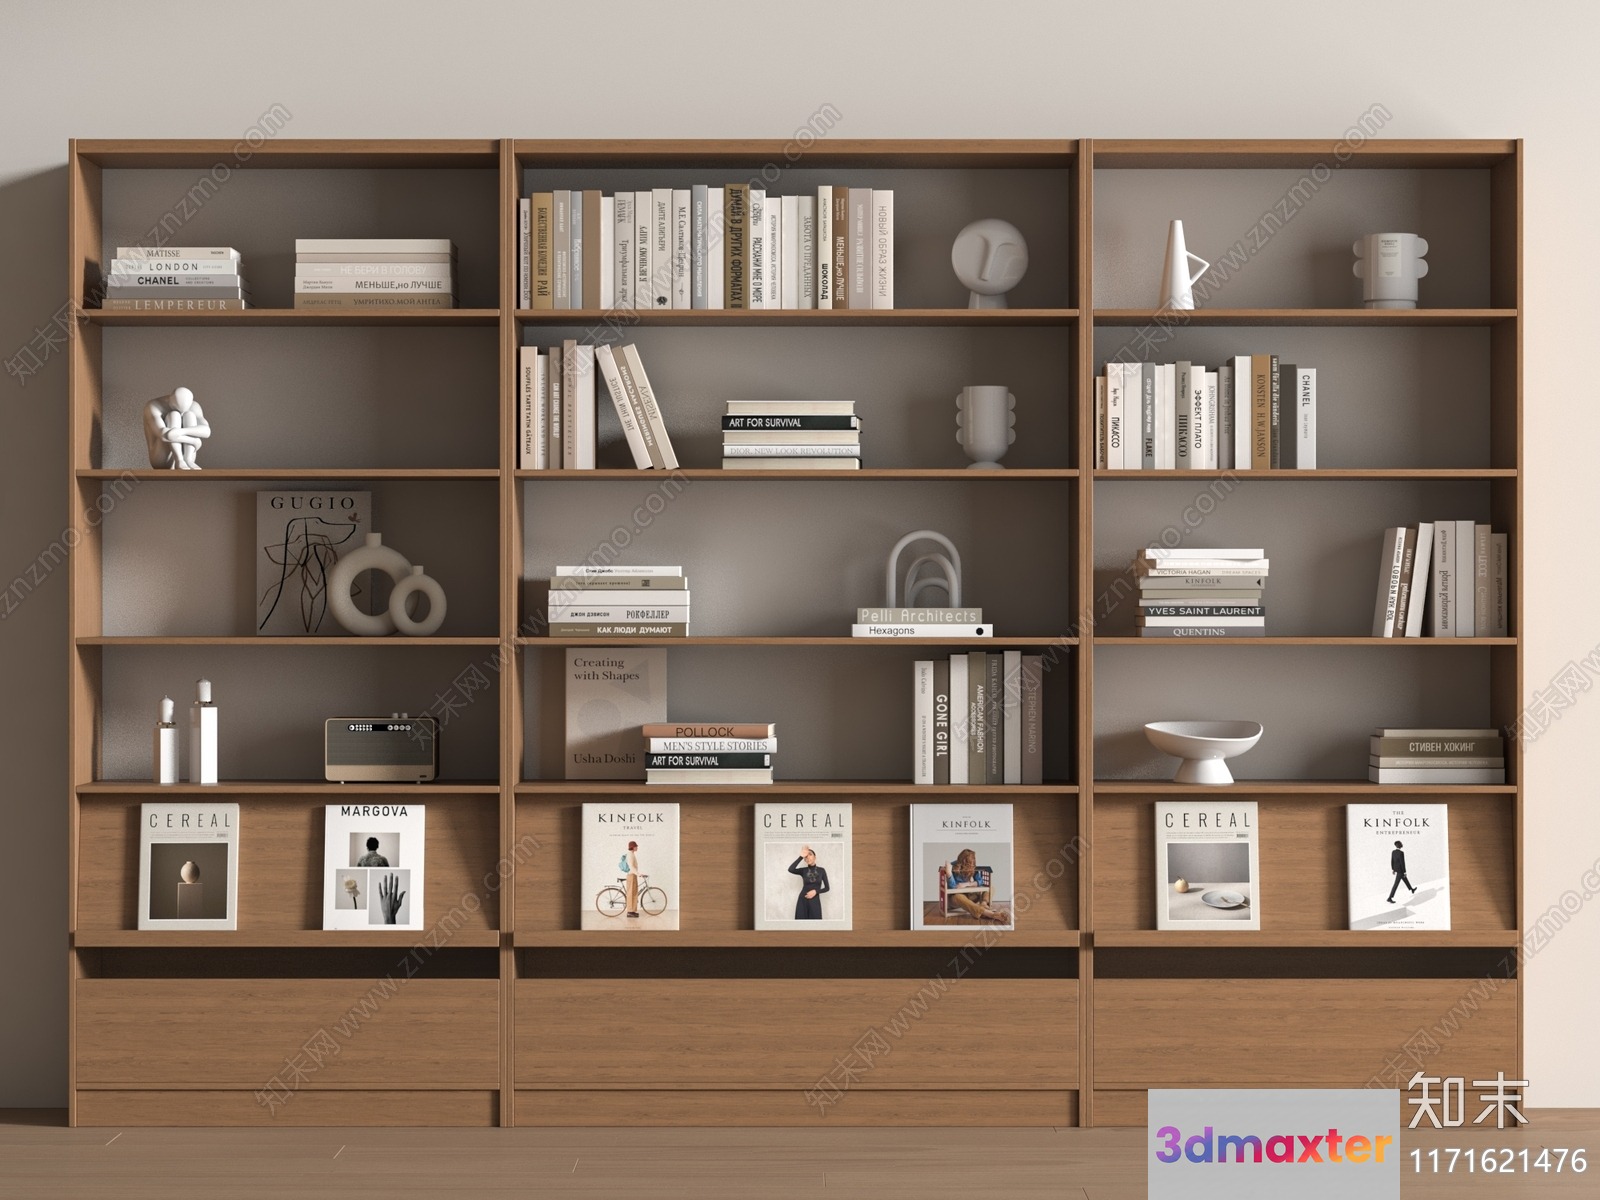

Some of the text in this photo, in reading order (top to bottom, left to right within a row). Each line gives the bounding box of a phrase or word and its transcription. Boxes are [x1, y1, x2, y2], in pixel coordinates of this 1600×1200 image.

[730, 188, 744, 216] ДУМАЙ
[658, 201, 666, 221] ДАНТЕ
[537, 207, 548, 249] БОЖЕСТВЕННАЯ
[639, 225, 648, 245] МИРУ
[802, 216, 812, 243] ЗАБОТА
[730, 226, 741, 257] ДРУГИХ
[146, 250, 180, 258] MATISSE
[752, 237, 762, 268] РАССКАЖИ
[878, 205, 888, 297] НОВЫЙ ОБРАЗ ЖИЗНИ
[149, 263, 198, 271] LONDON
[639, 247, 648, 276] ВЕЧНОМУ
[340, 266, 352, 275] НЕ
[354, 266, 379, 275] БЕРИ
[381, 266, 388, 275] В
[389, 266, 427, 275] ГОЛОВУ
[752, 268, 762, 281] МНЕ
[802, 252, 812, 298] ПРЕДАННЫХ
[137, 277, 179, 285] CHANEL
[410, 281, 442, 290] ЛУЧШЕ
[730, 259, 741, 301] ФОРМАТАХ
[820, 263, 829, 301] ШОКОЛАД
[537, 280, 550, 297] РАЙ
[752, 287, 762, 303] МОРЕ
[836, 276, 845, 301] ЛУЧШЕ
[135, 300, 228, 310] LEMPEREUR
[1257, 374, 1266, 408] KONSTEN
[1302, 375, 1311, 407] CHANEL
[729, 418, 801, 428] ART FOR SURVIVAL
[1194, 390, 1202, 449] ЭФФЕКТ ПЛАТО
[1111, 416, 1120, 448] ПИКАССО
[1178, 414, 1188, 457] ПИКАССО
[755, 447, 774, 455] NEW
[775, 447, 798, 455] LOOK
[800, 447, 853, 455] REVOLUTION
[1145, 437, 1153, 457] FLAKE
[271, 497, 354, 510] GUGIO
[626, 610, 670, 619] РОКФЕЛЛЕР
[861, 609, 977, 622] Pelli Architects
[1148, 607, 1261, 615] YVES SAINT LAURENT
[869, 626, 915, 637] Hexagons
[1173, 628, 1226, 637] QUENTINS
[574, 657, 625, 670] Creating
[574, 671, 640, 683] with Shapes
[936, 694, 948, 757] GONE GIRL
[976, 684, 984, 753] AMERICAN FASHION
[1027, 687, 1037, 754] STEPHEN MARINO
[675, 727, 735, 737] POLLOCK
[694, 741, 724, 751] STYLE
[726, 741, 768, 751] STORIES
[1409, 742, 1476, 752] СТИВЕН ХОКИНГ
[574, 754, 636, 764] Usha Doshi
[651, 756, 719, 766] ART FOR SURVIVAL
[341, 806, 408, 817] MARGOVA
[598, 813, 664, 823] KINFOLK
[149, 813, 230, 828] CEREAL
[763, 813, 844, 828] CEREAL
[942, 820, 991, 828] KINFOLK
[1165, 812, 1250, 828] CEREAL
[1364, 818, 1430, 828] KINFOLK
